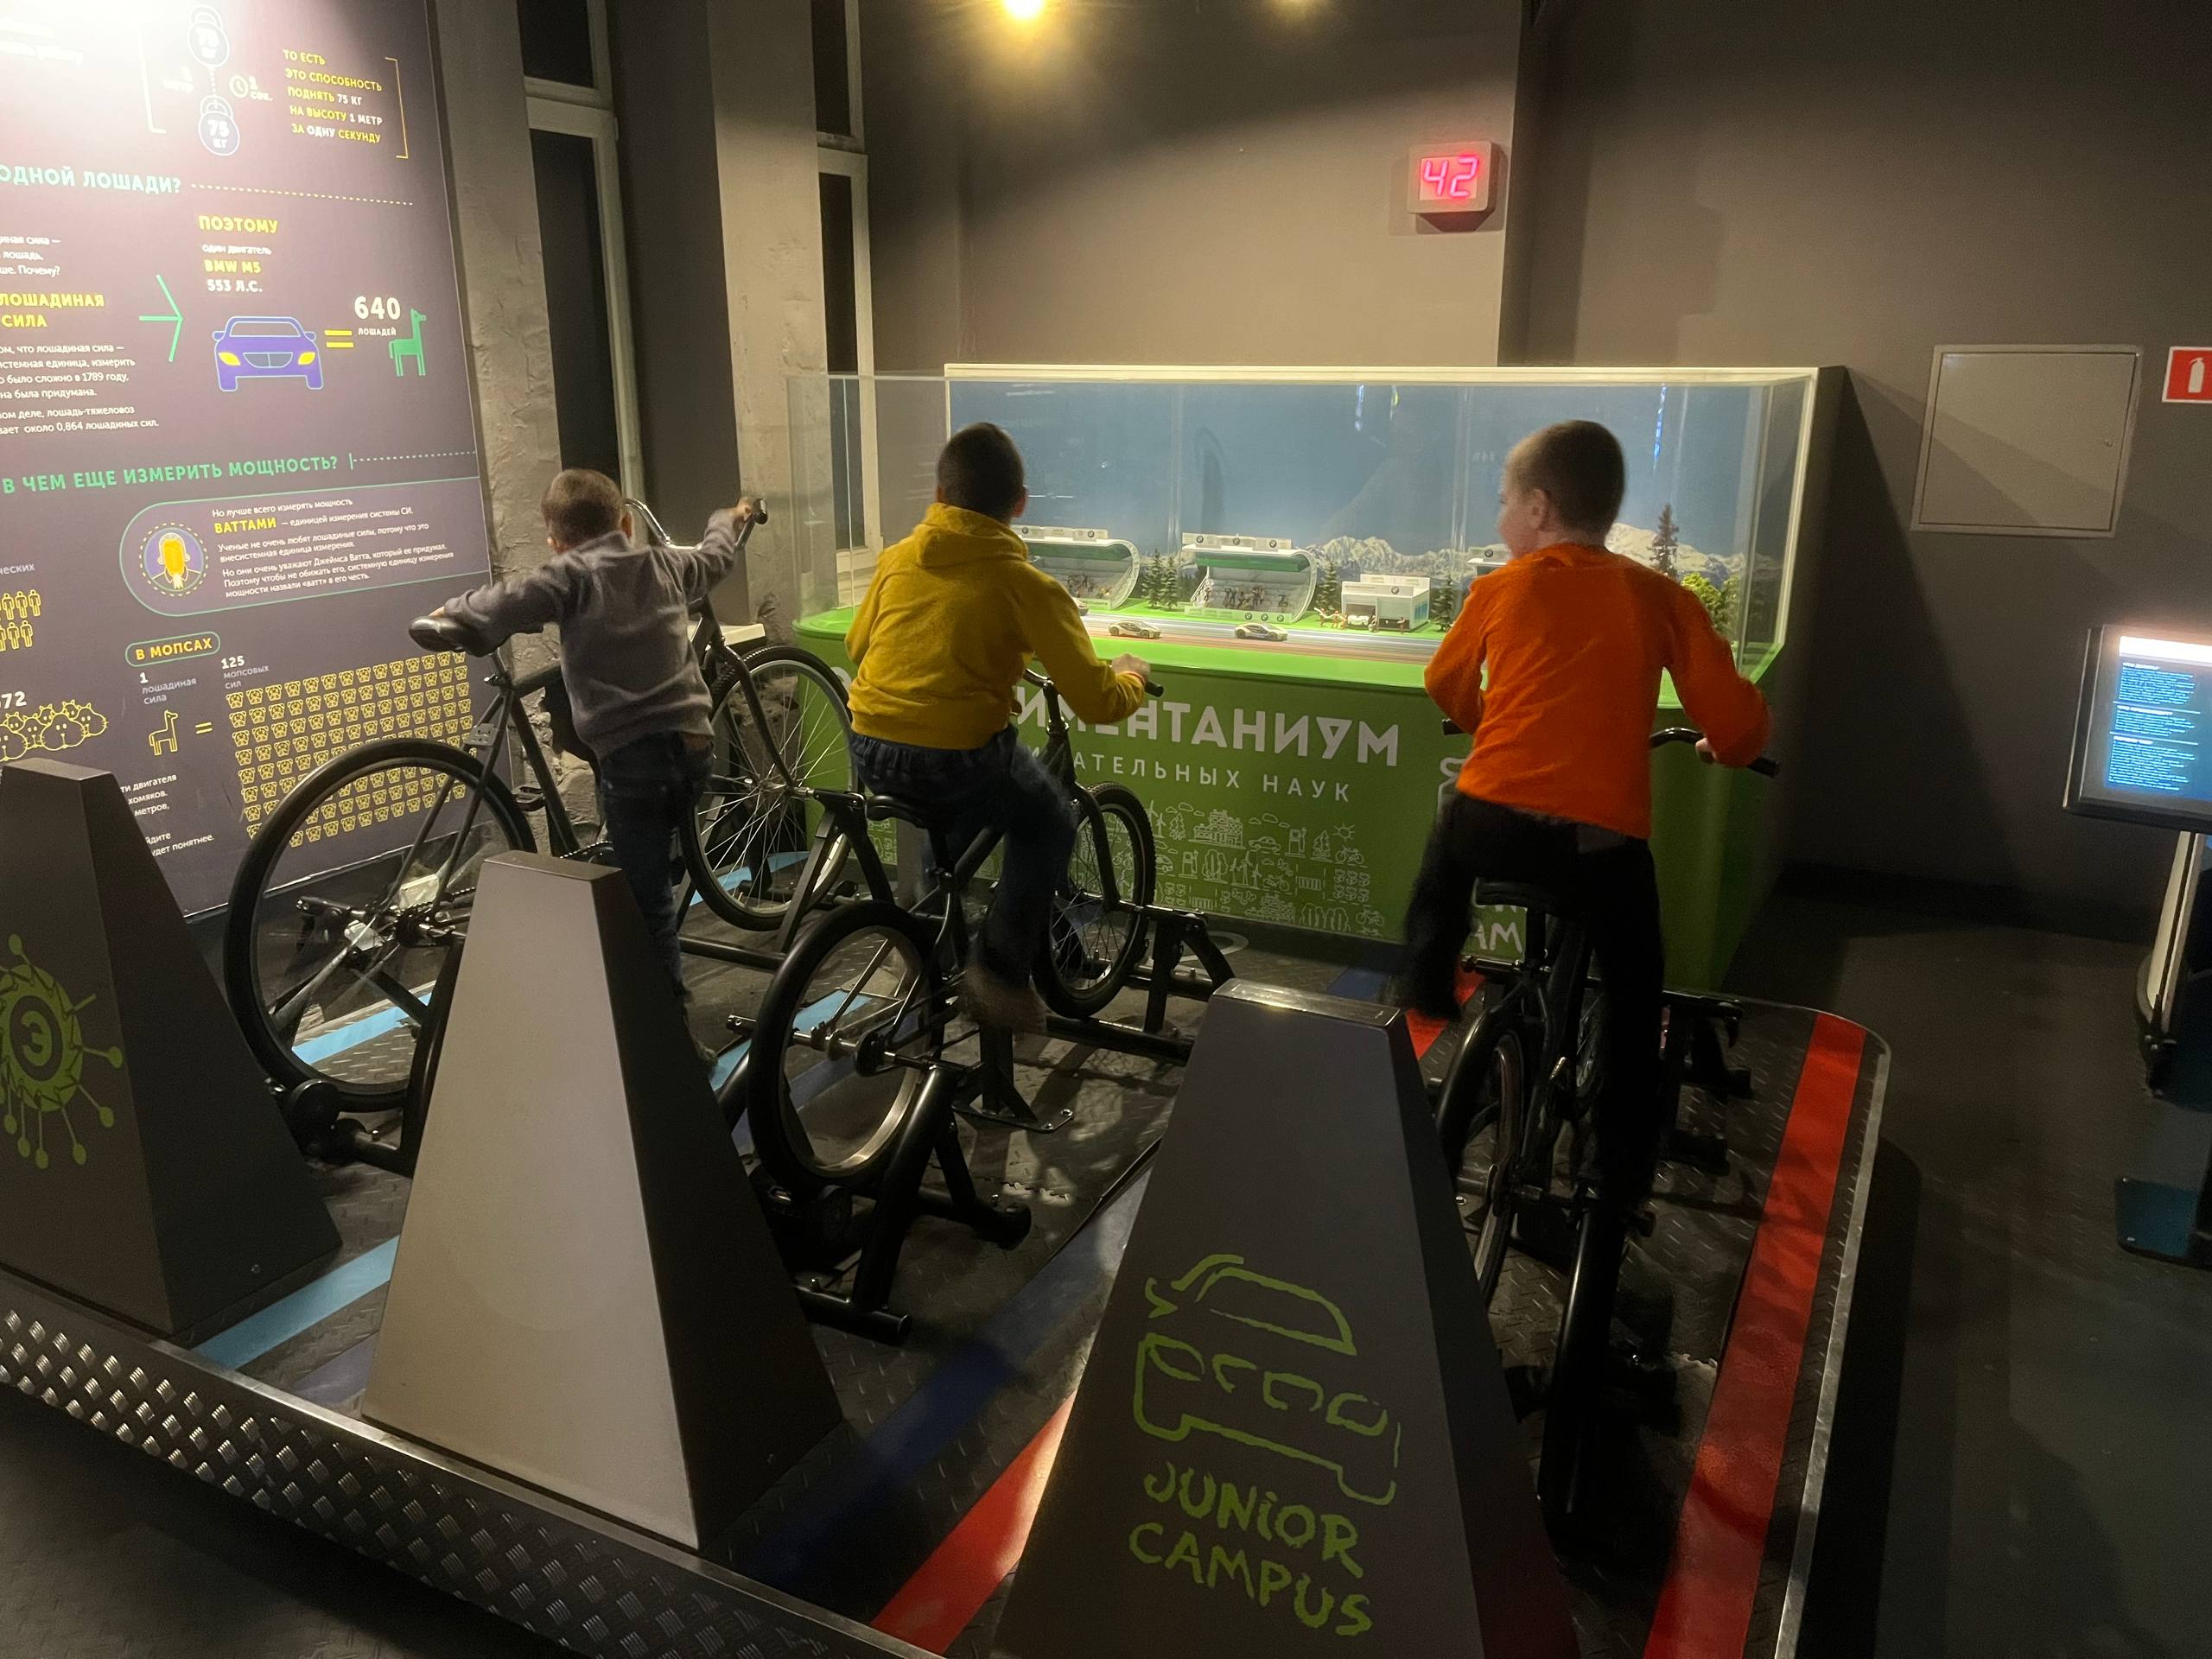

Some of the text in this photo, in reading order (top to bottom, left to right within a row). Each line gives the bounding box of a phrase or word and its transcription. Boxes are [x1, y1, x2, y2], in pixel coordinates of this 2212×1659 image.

[283, 49, 325, 65] ТО ЕСТЬ
[285, 68, 382, 92] ЭТО СПОСОБНОСТЬ
[288, 86, 362, 105] ПОДНЯТЬ 75 КГ
[290, 105, 383, 125] НА ВЫСОТУ 1 МЕТР
[292, 123, 380, 143] ЗА ОДНУ СЕКУНДУ
[0, 164, 181, 194] ОДНОЙ ЛОШАДИ?
[1424, 156, 1479, 198] 42
[199, 215, 278, 233] ПОЭТОМУ
[202, 244, 272, 255] один двигатель
[17, 264, 60, 277] Почему?
[204, 259, 261, 274] BMW M5
[207, 279, 263, 292] 553 Л.С.
[0, 293, 105, 308] ЛОШАДИНАЯ
[354, 296, 401, 320] 640
[1, 315, 48, 327] СИЛА
[358, 327, 397, 337] ЛОШАДЕЙ
[37, 345, 90, 354] лошадиная
[92, 358, 136, 368] измерить
[6, 374, 33, 384] было
[82, 372, 104, 382] 1789
[15, 389, 39, 398] была
[47, 406, 135, 417] лошадь-тяжеловоз
[24, 424, 54, 433] около
[86, 420, 138, 430] лошадиных
[2, 455, 338, 494] В ЧЕМ ЕЩЕ ИЗМЕРИТЬ МОЩНОСТЬ?
[213, 499, 353, 518] Но лучше всего измерять мощность
[214, 518, 276, 534] ВАТТАМИ
[290, 515, 327, 526] единицей
[329, 513, 368, 522] измерения
[369, 509, 400, 518] системы
[218, 543, 249, 552] Ученые
[288, 536, 311, 544] любят
[313, 531, 355, 541] лошадиные
[378, 526, 403, 535] потому
[220, 550, 277, 563] внесистемная
[279, 546, 312, 556] единица
[279, 561, 312, 572] уважают
[314, 555, 348, 567] Джеймса
[372, 548, 403, 558] который
[224, 577, 260, 588] Поэтому
[261, 573, 286, 582] чтобы
[299, 568, 330, 578] обижать
[347, 560, 388, 570] системную
[226, 585, 269, 598] мощности
[270, 582, 301, 592] назвали
[136, 638, 212, 661] В МОПСАХ
[220, 656, 245, 669] 125
[139, 671, 149, 684] 1
[223, 664, 269, 679] мопсовых
[142, 677, 197, 695] лошадиная
[226, 679, 241, 690] сил
[0, 691, 27, 709] 72
[143, 694, 167, 705] сила
[133, 774, 177, 791] двигателя
[1263, 774, 1350, 803] НАУК
[1128, 1522, 1373, 1637] CAMPUS
